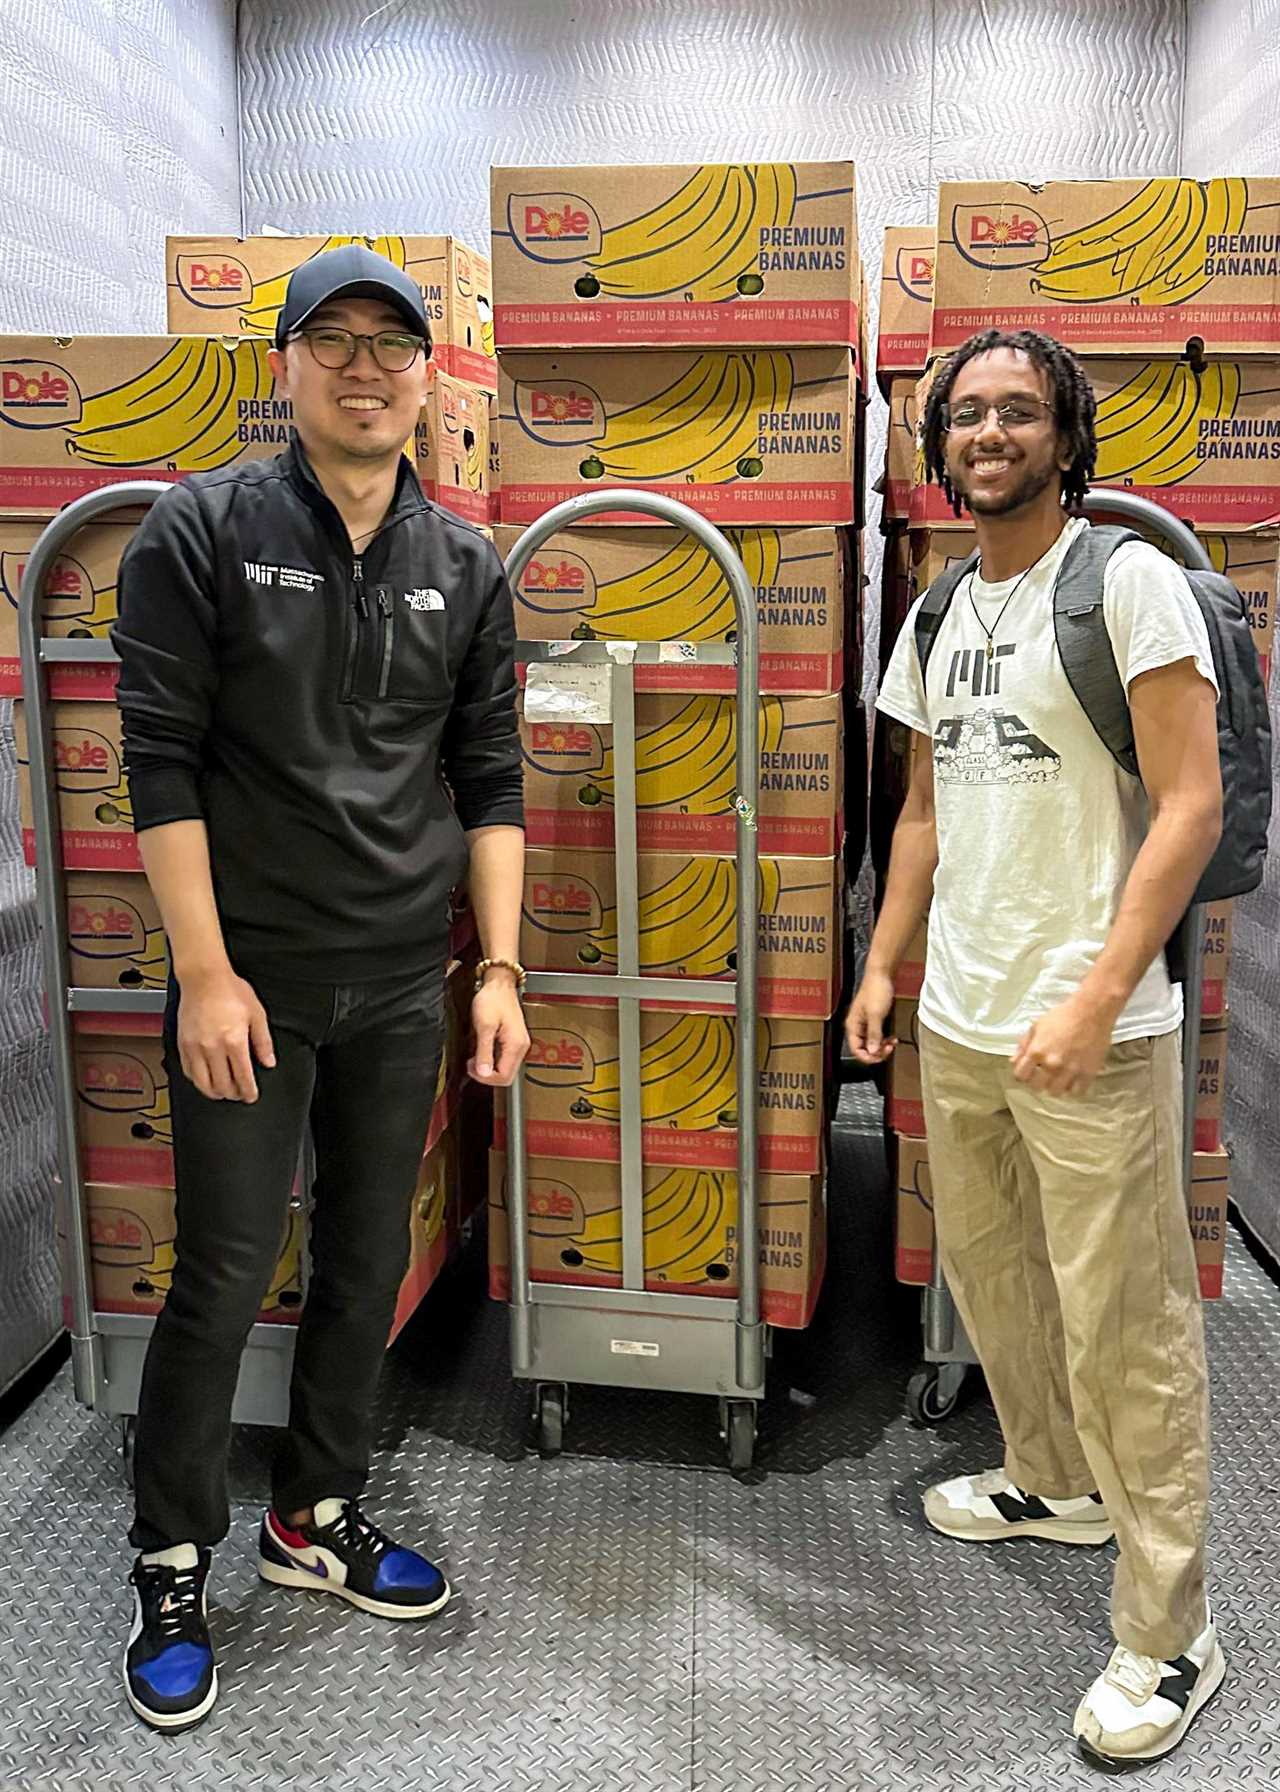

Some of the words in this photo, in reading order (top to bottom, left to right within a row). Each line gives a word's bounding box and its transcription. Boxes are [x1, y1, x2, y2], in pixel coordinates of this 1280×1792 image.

[524, 204, 590, 235] Dole
[970, 214, 1038, 243] Dole
[759, 226, 845, 246] PREMIUM
[759, 251, 846, 271] BANANAS
[1204, 258, 1280, 276] BANANA
[190, 263, 244, 287] Dole
[502, 311, 550, 324] PREMIUM
[552, 310, 602, 324] BANANAS
[616, 310, 666, 323] PREMIUM
[668, 309, 720, 322] BANANAS
[734, 309, 785, 321] PREMIUM
[788, 308, 840, 321] BANANAS
[943, 315, 993, 327] PREMIUM
[995, 313, 1046, 326] BANANAS
[1060, 312, 1111, 324] PREMIUM
[1113, 312, 1166, 324] BANANAS
[1180, 311, 1230, 323] PREMIUM
[2, 370, 69, 401] Dole
[237, 400, 293, 420] PREMI
[531, 391, 595, 420] Dole
[759, 412, 841, 432] PREMIUM
[1199, 419, 1280, 438] PREMIUM
[238, 424, 289, 443] BANA
[758, 434, 842, 454] BANANAS
[1198, 441, 1280, 460] BANANAS
[510, 491, 554, 503] PREMIUM
[672, 490, 720, 502] BANANAS
[734, 489, 785, 501] PREMIUM
[786, 489, 838, 501] BANANAS
[243, 561, 278, 585] MIT
[524, 559, 585, 588] Dole
[280, 578, 316, 593] Technology
[412, 589, 430, 598] THE
[753, 586, 827, 604] REMIUM
[404, 593, 430, 605] NORTH
[410, 603, 430, 611] FACE
[757, 607, 828, 626] ANANAS
[772, 660, 822, 672] BANANAS
[946, 643, 1017, 697] MIT
[532, 723, 593, 750] Dole
[760, 752, 829, 771] REMIUM
[966, 756, 985, 764] CLASS
[760, 772, 830, 792] ANANAS
[664, 820, 713, 833] BANANAS
[75, 837, 123, 850] BANANAS
[533, 883, 592, 909] Dole
[70, 904, 134, 933] Dole
[758, 914, 826, 933] REMIUM
[758, 934, 827, 954] ANANAS
[759, 1071, 816, 1089] EMIUM
[759, 1092, 816, 1110] NANAS
[725, 1226, 803, 1248] PMIUM
[725, 1248, 804, 1269] BANAS
